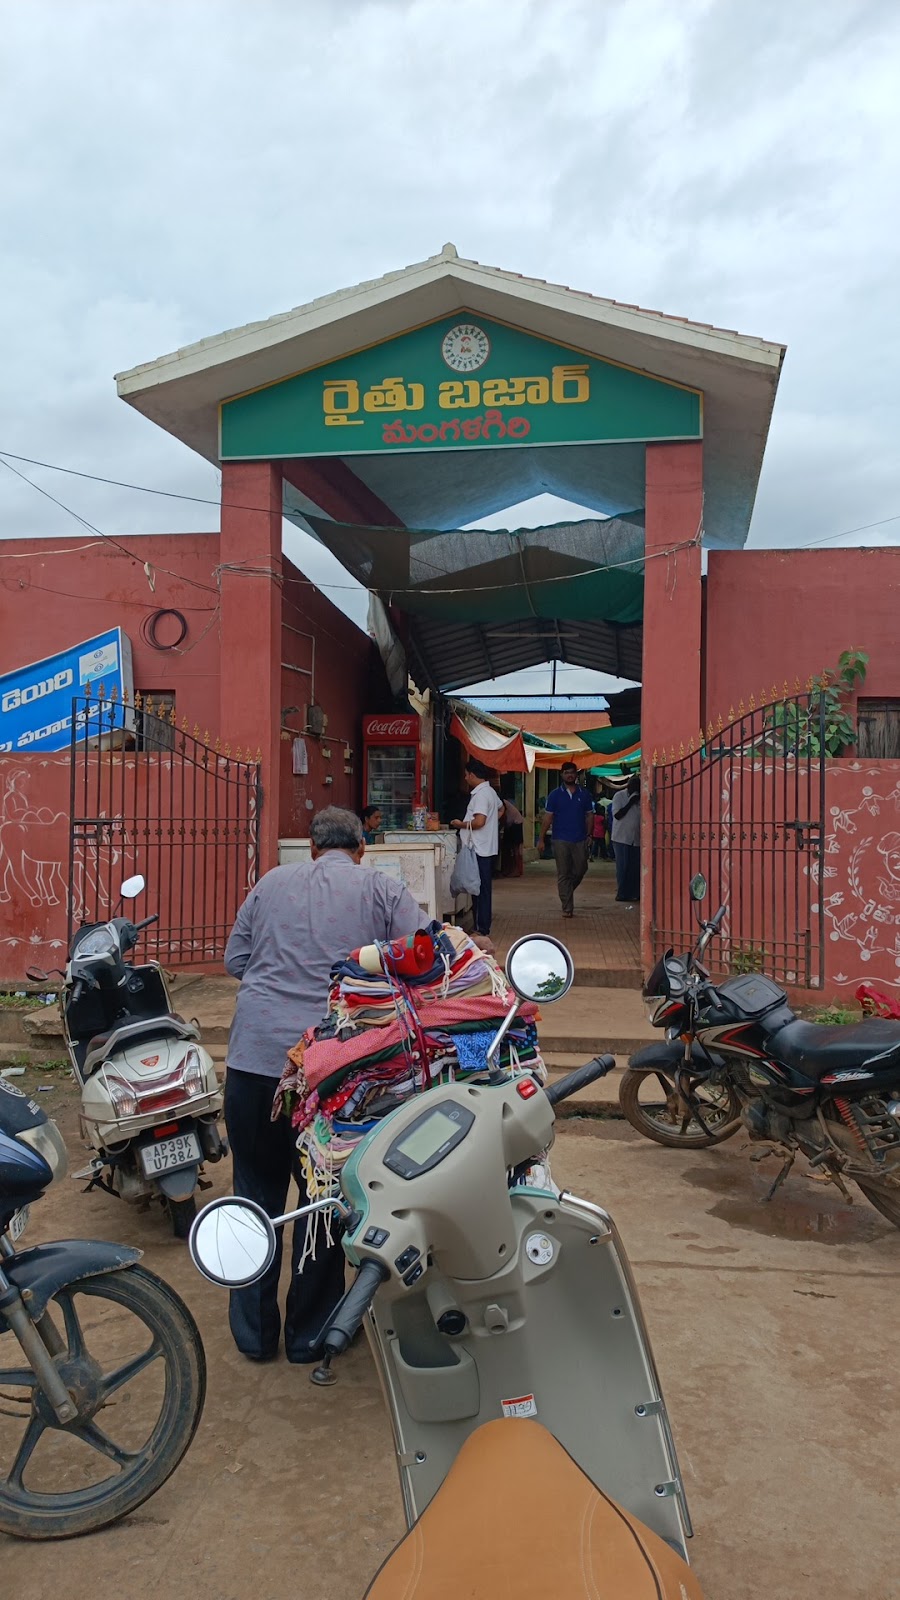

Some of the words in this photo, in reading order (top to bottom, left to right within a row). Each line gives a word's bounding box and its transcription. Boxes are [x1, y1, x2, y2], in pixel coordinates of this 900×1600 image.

[323, 377, 424, 426] రైతు
[438, 364, 590, 408] బజార్
[382, 409, 531, 444] మంగళగిరి
[154, 1136, 192, 1158] AP39K
